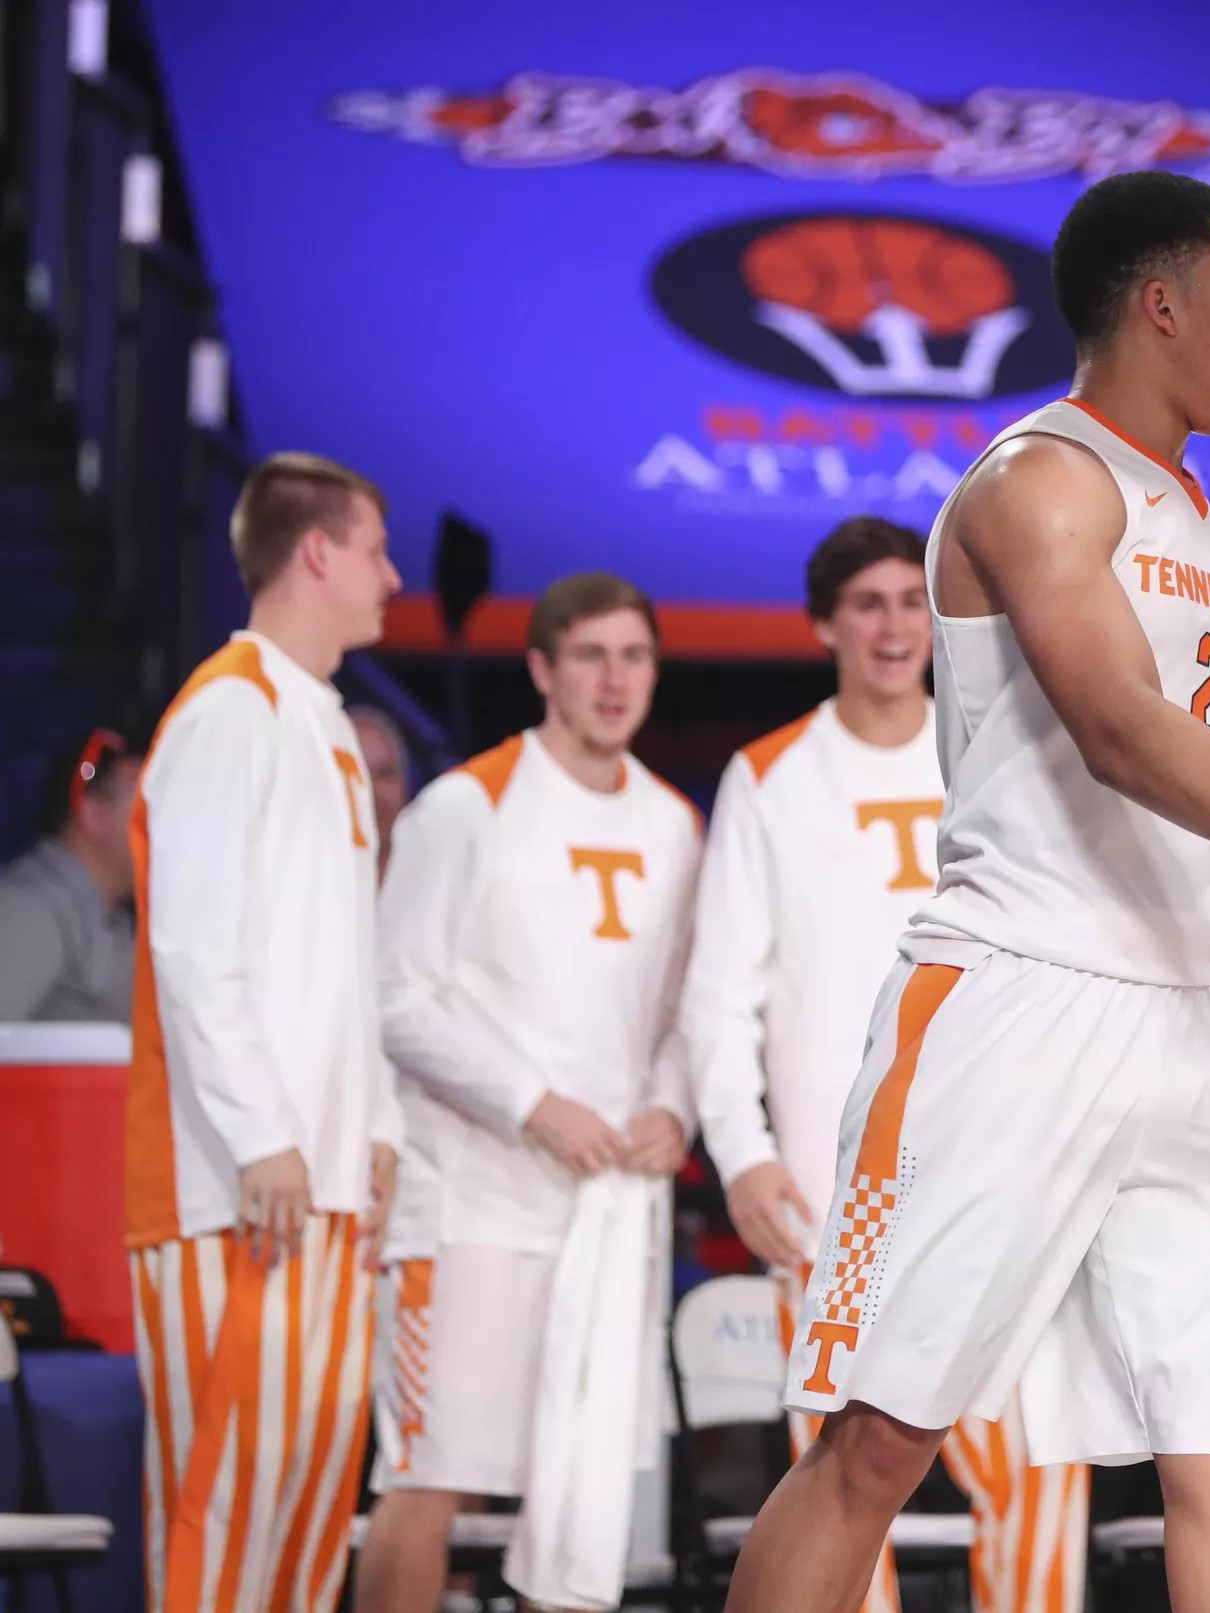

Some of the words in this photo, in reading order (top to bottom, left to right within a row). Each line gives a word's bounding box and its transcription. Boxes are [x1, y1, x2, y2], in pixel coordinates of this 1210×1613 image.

[855, 797, 945, 891] T
[567, 846, 646, 941] T
[803, 1321, 860, 1396] T
